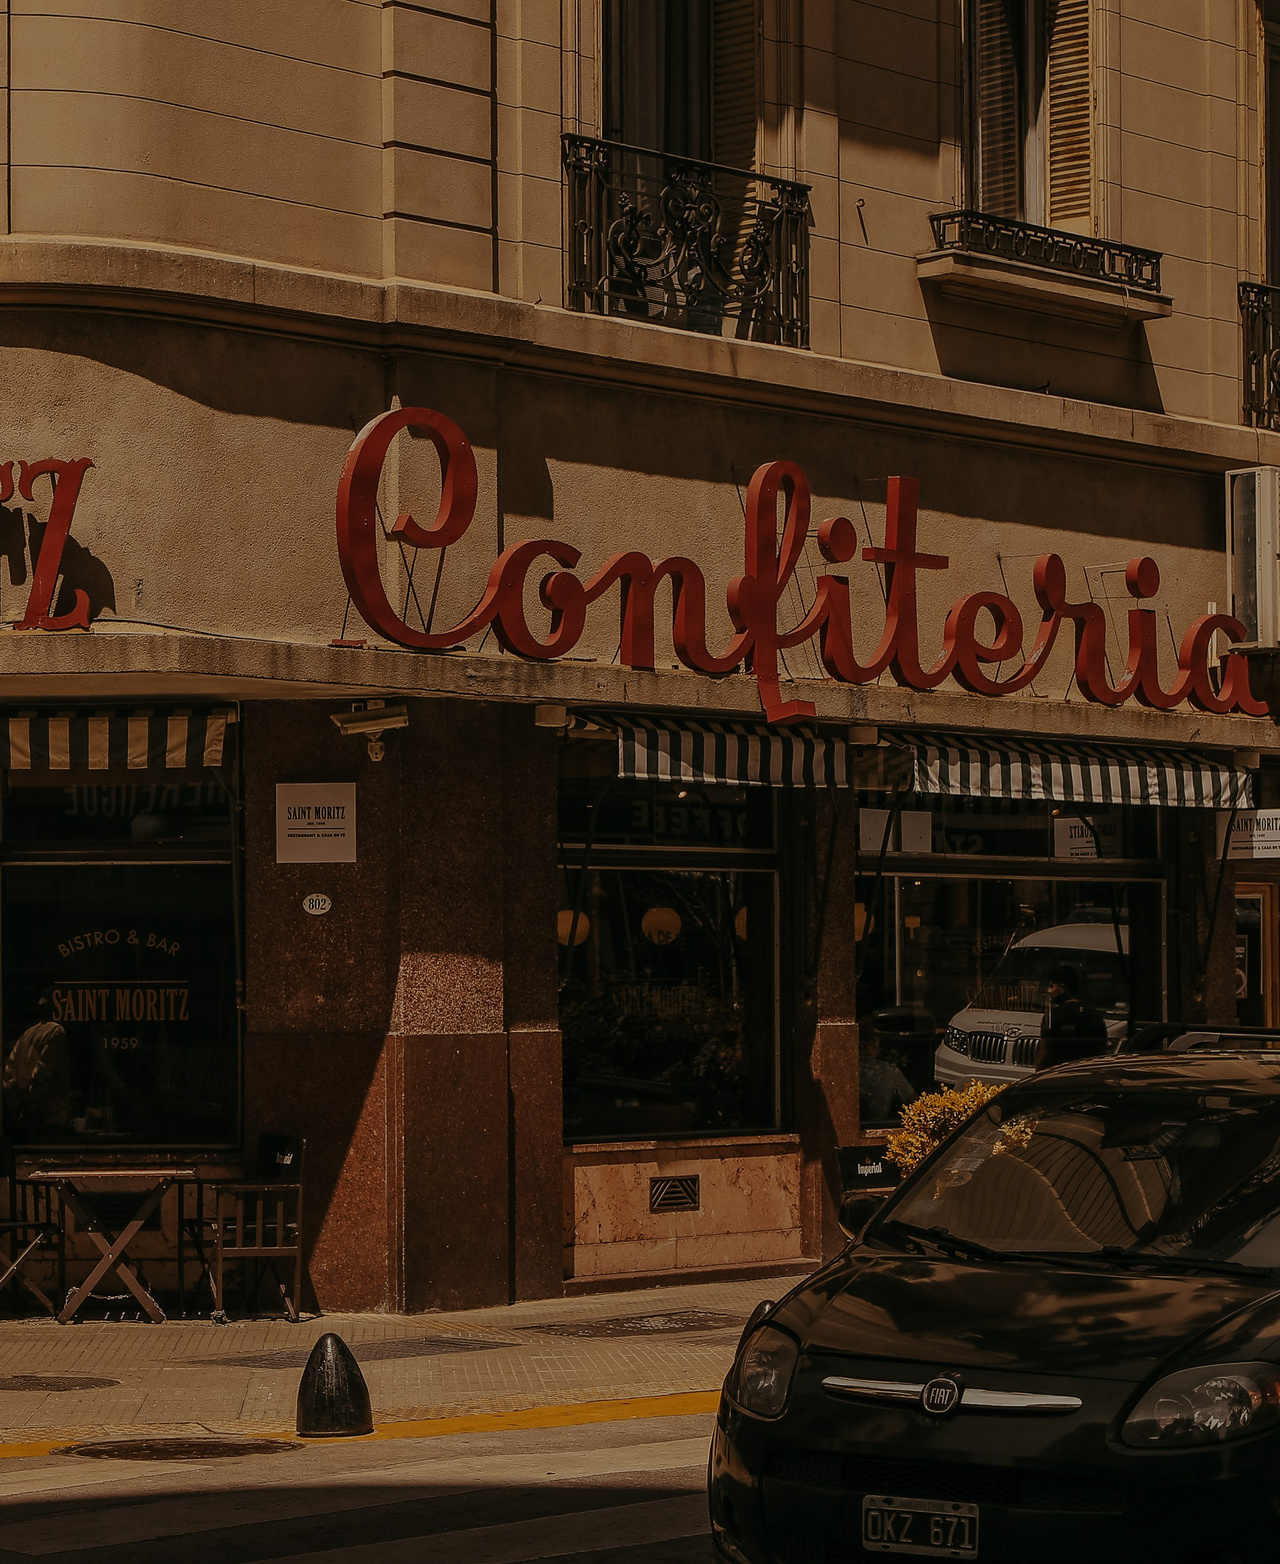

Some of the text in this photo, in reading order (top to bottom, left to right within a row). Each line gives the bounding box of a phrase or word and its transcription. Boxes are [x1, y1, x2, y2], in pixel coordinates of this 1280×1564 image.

[335, 405, 1271, 724] Confiteria
[287, 806, 346, 820] SAINT MORITZ
[308, 898, 326, 910] 802
[57, 929, 181, 958] BISTRO & BAR
[52, 988, 190, 1022] SAINT MORITZ
[103, 1037, 139, 1050] 1959
[857, 1161, 882, 1177] Imperial
[929, 1387, 952, 1405] FIAT
[899, 1500, 945, 1511] ARGENTINA
[867, 1510, 973, 1549] OKZ 671
